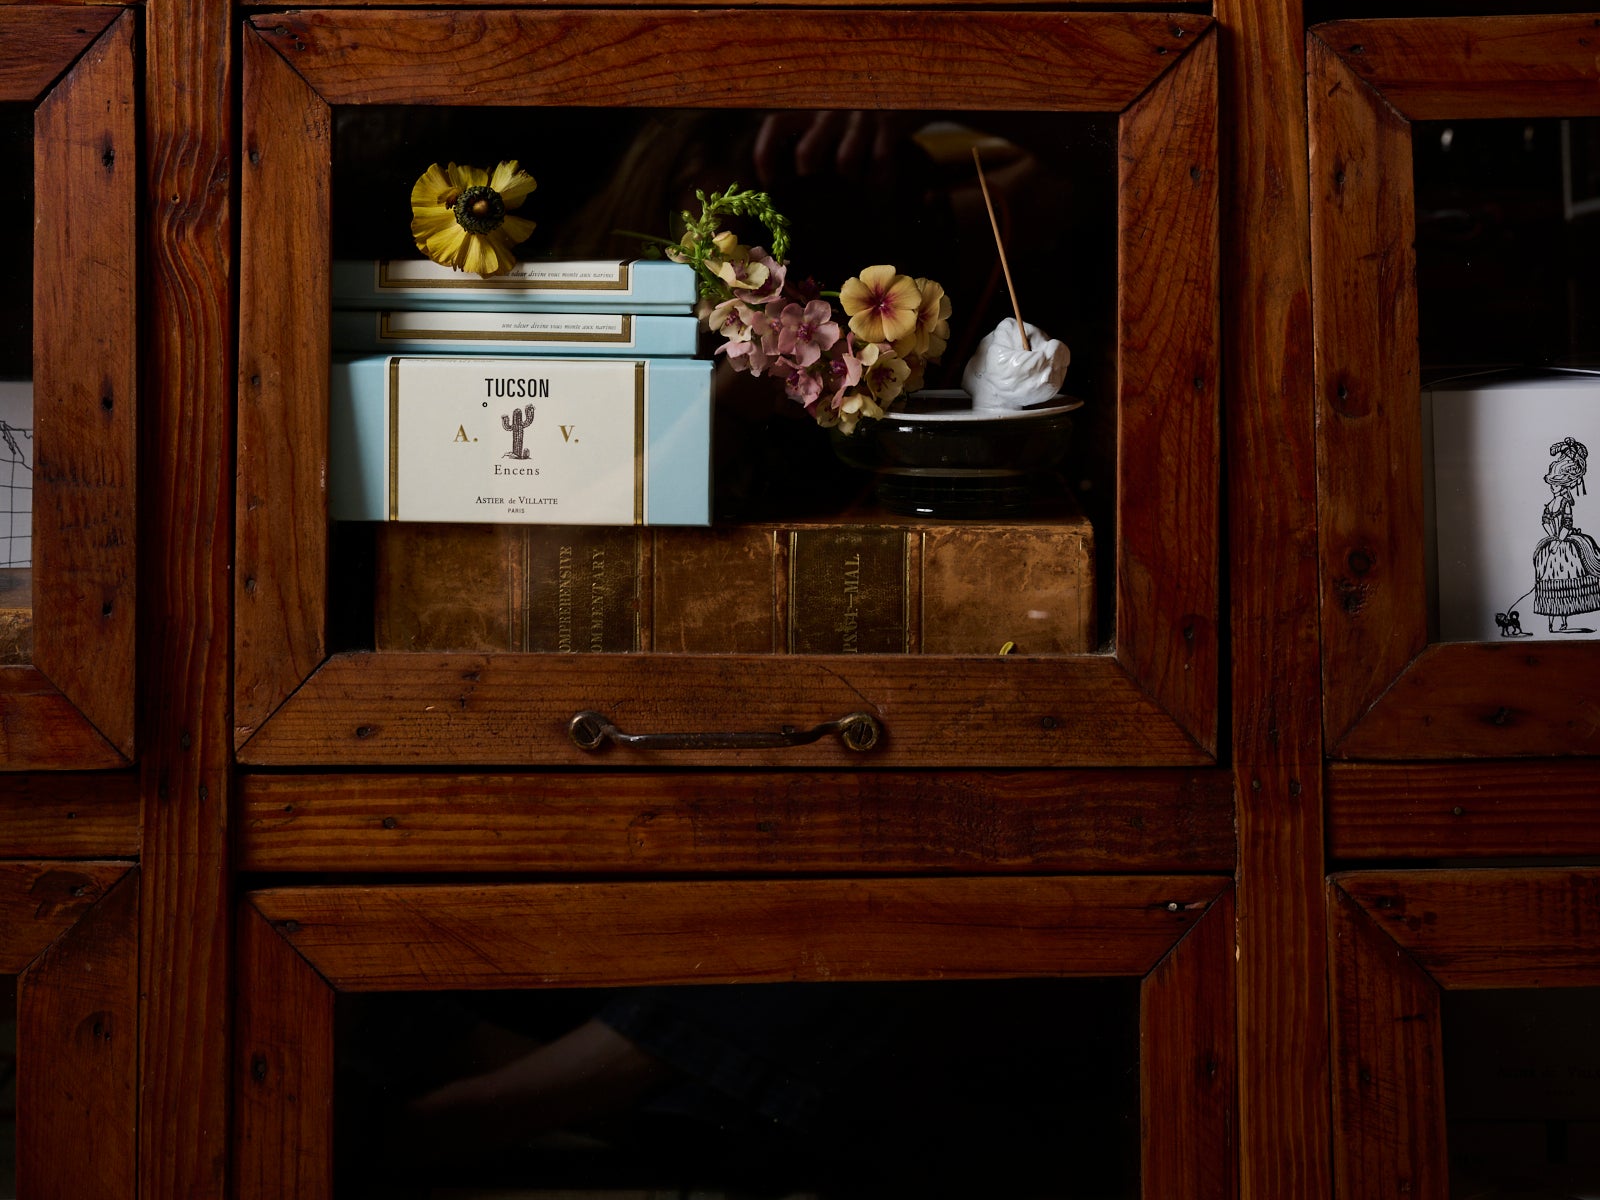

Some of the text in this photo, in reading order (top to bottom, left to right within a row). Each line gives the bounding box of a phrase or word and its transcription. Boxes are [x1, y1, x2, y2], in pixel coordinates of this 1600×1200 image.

[485, 378, 549, 398] TUCSON
[453, 424, 579, 444] A. V.
[494, 464, 540, 476] Encens
[475, 496, 504, 504] ASTIER
[518, 496, 558, 505] VILLATTE
[559, 546, 571, 653] OMPREHENSIVE
[591, 549, 604, 653] OMMENTARY
